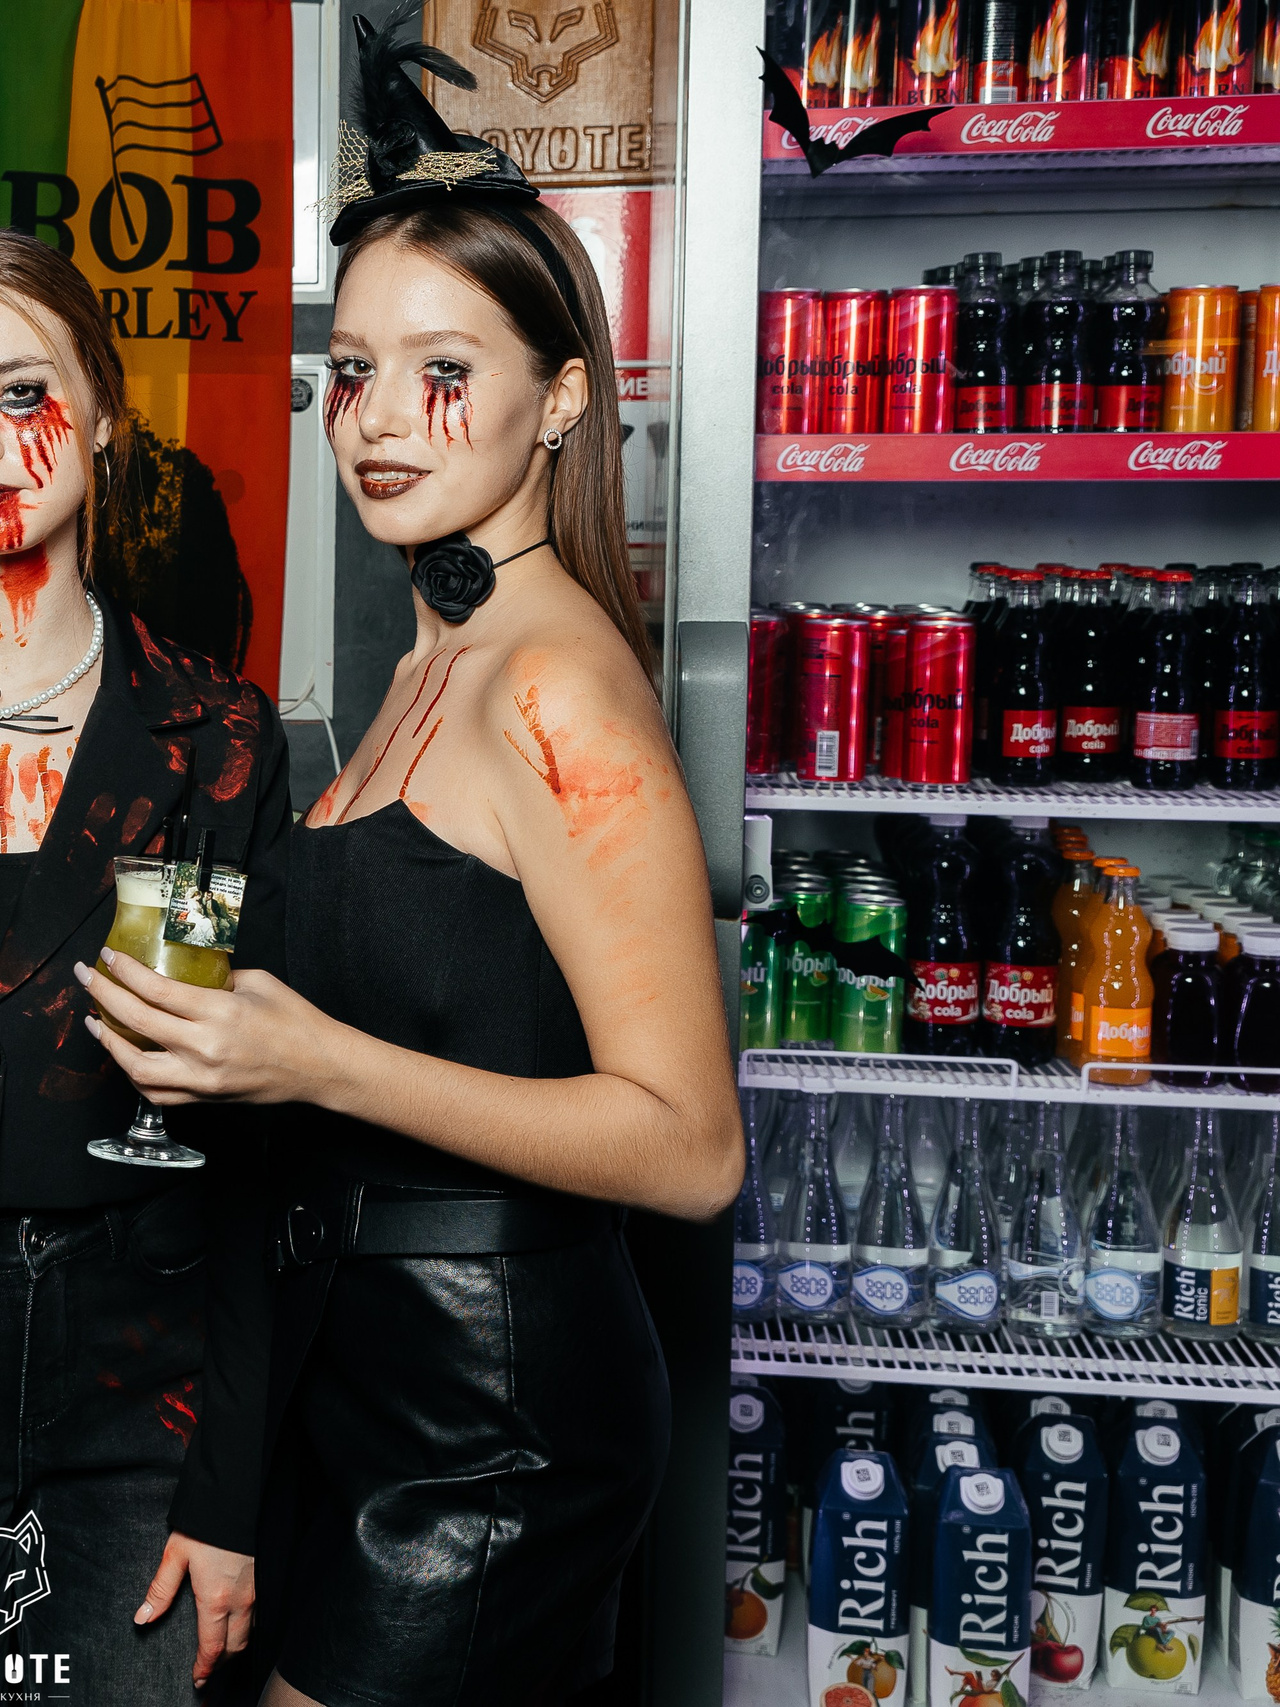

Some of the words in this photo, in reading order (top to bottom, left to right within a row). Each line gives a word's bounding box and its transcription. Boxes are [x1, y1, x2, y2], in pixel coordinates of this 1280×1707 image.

[908, 88, 961, 104] BURN
[960, 111, 1061, 145] Coca-Cola
[1145, 104, 1250, 139] Coca-Cola
[453, 124, 645, 172] OYOTE
[1, 170, 262, 275] BOB
[99, 287, 259, 343] RLEY
[821, 354, 883, 379] обрый
[885, 352, 946, 377] обрый
[1157, 351, 1228, 379] обрый
[772, 383, 803, 395] cola
[829, 382, 858, 396] cola
[892, 381, 922, 395] cola
[776, 442, 870, 473] Coca-Cola
[949, 441, 1047, 472] Coca-Cola
[1128, 440, 1228, 471] Coca-Cola
[902, 688, 964, 713] обрый
[910, 716, 939, 728] cola
[933, 1004, 963, 1017] cola
[1005, 1007, 1035, 1020] cola
[1173, 1270, 1196, 1320] Rich
[1195, 1287, 1209, 1321] tonic
[835, 1411, 875, 1452] ch
[726, 1453, 763, 1556] Rich
[1034, 1480, 1087, 1590] Rich
[1136, 1484, 1184, 1594] Rich
[838, 1519, 888, 1632] Rich
[959, 1533, 1009, 1646] Rich
